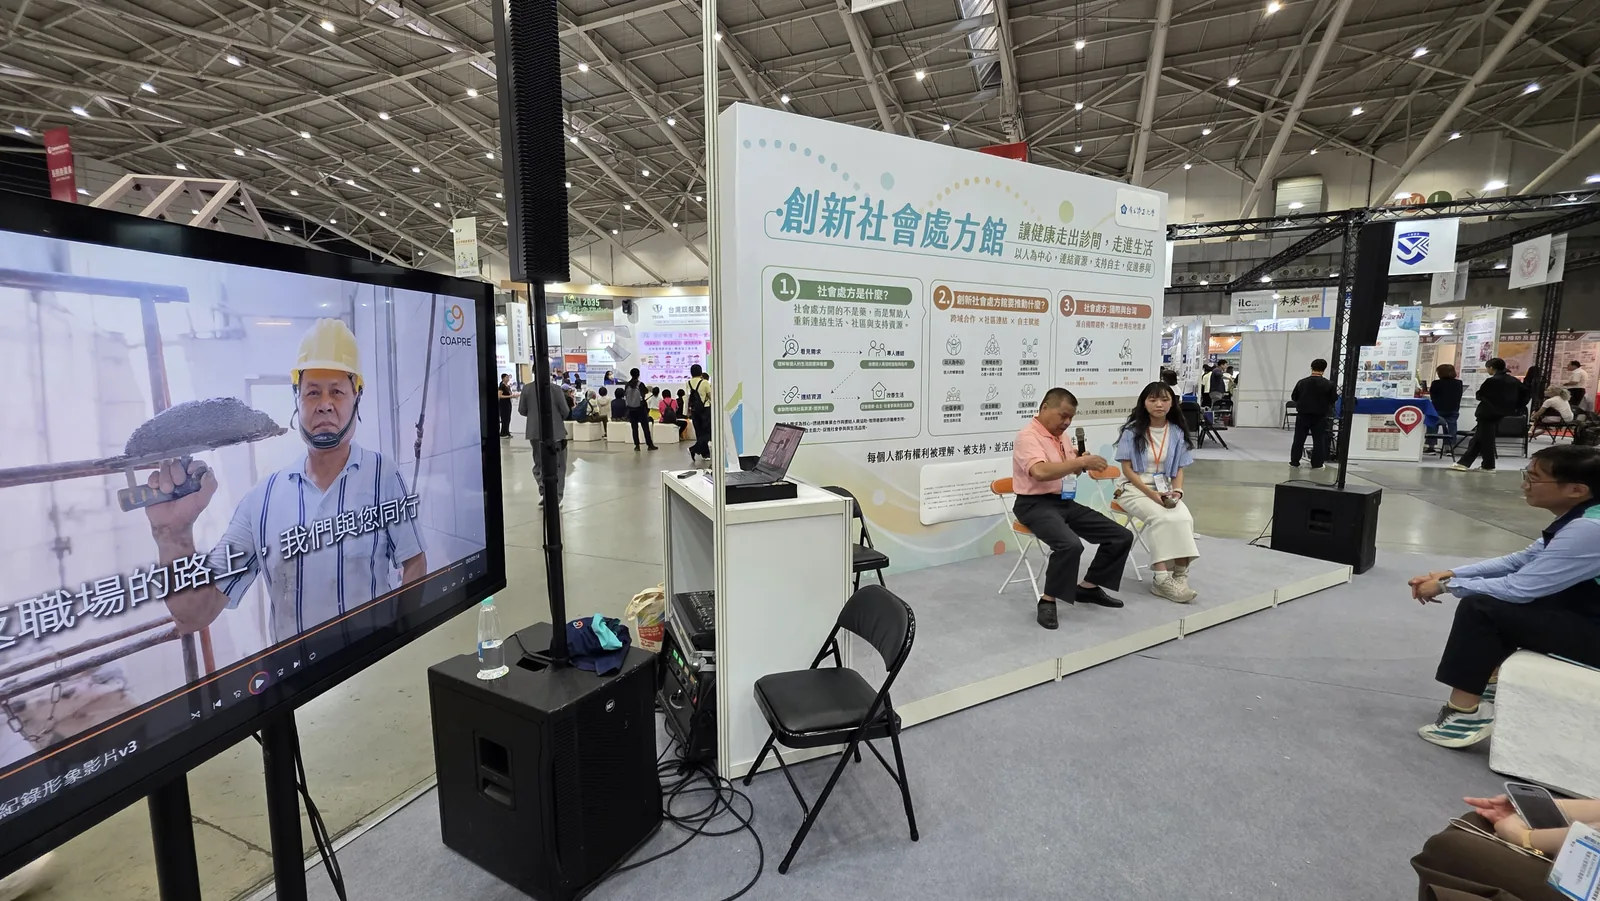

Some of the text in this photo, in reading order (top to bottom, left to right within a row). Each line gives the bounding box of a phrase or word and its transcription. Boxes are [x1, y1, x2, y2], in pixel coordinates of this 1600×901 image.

[780, 186, 1007, 257] 創新社會處方館
[1018, 221, 1154, 257] 讓健康走出診間，走進生活
[1014, 247, 1152, 274] 以人為中心，連結資源，支持自主，促進參與
[779, 278, 795, 295] 1.
[938, 290, 950, 304] 2.
[794, 304, 911, 319] 社會處方開的不是藥，而是幫助人
[1063, 299, 1073, 312] 3.
[793, 316, 909, 330] 重新連結生活、社區與支持資源。
[440, 336, 471, 347] COAPRE
